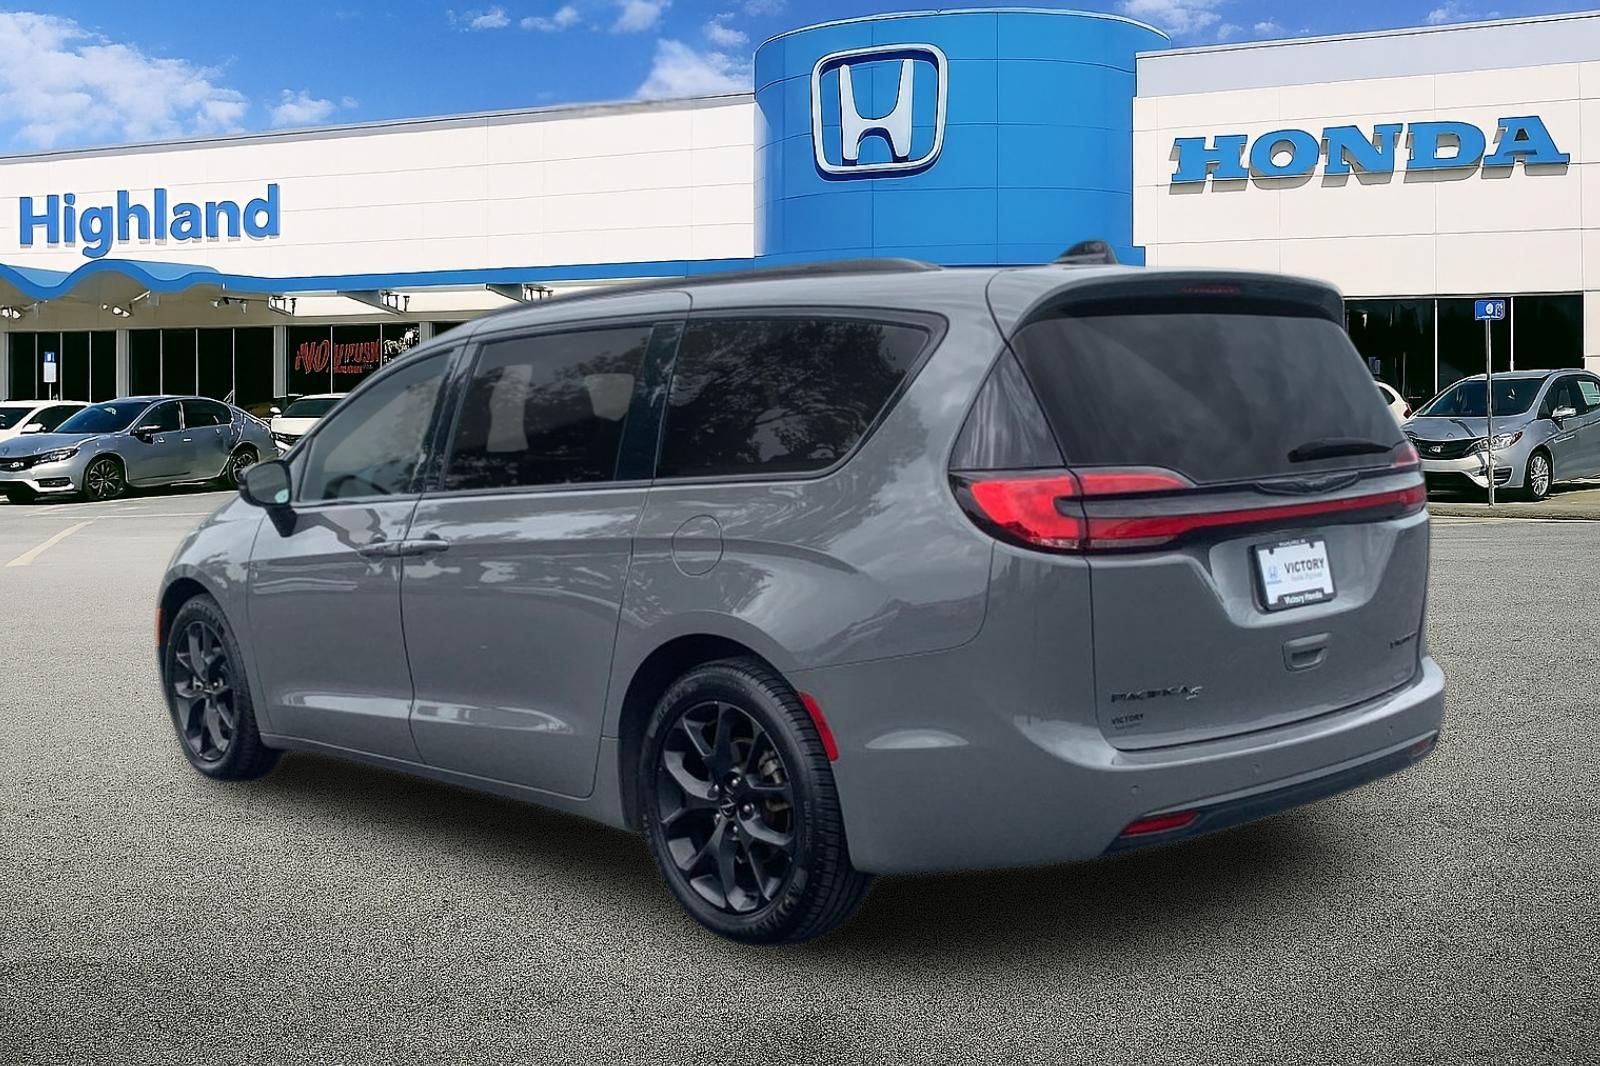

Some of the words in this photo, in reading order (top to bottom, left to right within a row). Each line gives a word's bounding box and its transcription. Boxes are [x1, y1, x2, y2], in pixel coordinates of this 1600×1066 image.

[1170, 115, 1571, 190] HONDA
[19, 183, 281, 258] Highland
[1284, 557, 1325, 574] VICTORY
[1111, 713, 1144, 725] VICTORY
